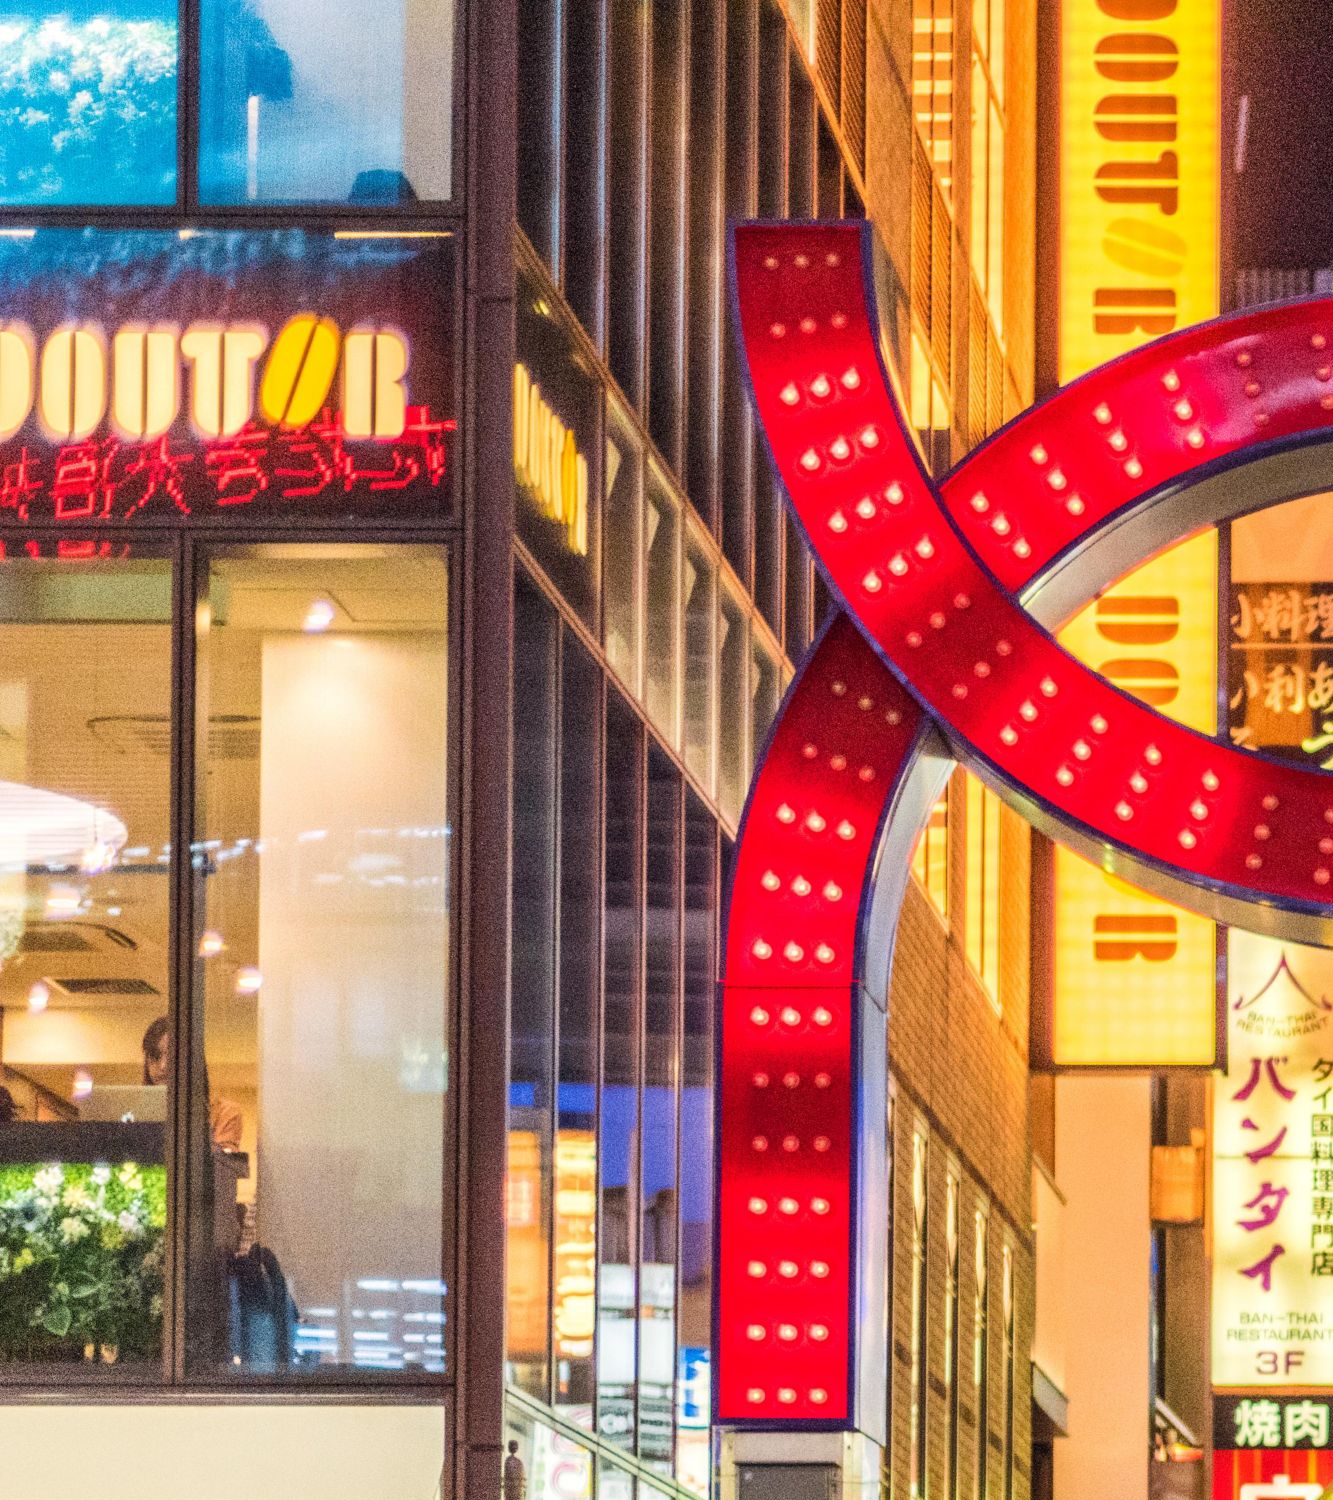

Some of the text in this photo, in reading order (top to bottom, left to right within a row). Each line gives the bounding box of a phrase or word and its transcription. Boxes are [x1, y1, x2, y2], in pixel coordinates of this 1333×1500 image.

[1093, 0, 1186, 335] OUTOR
[1233, 1056, 1297, 1291] バンタイ
[1226, 1328, 1333, 1343] RESTAURANT
[1240, 1312, 1324, 1326] BAN-THAI
[1255, 1350, 1306, 1375] 3F
[1234, 1398, 1331, 1448] 焼肉
